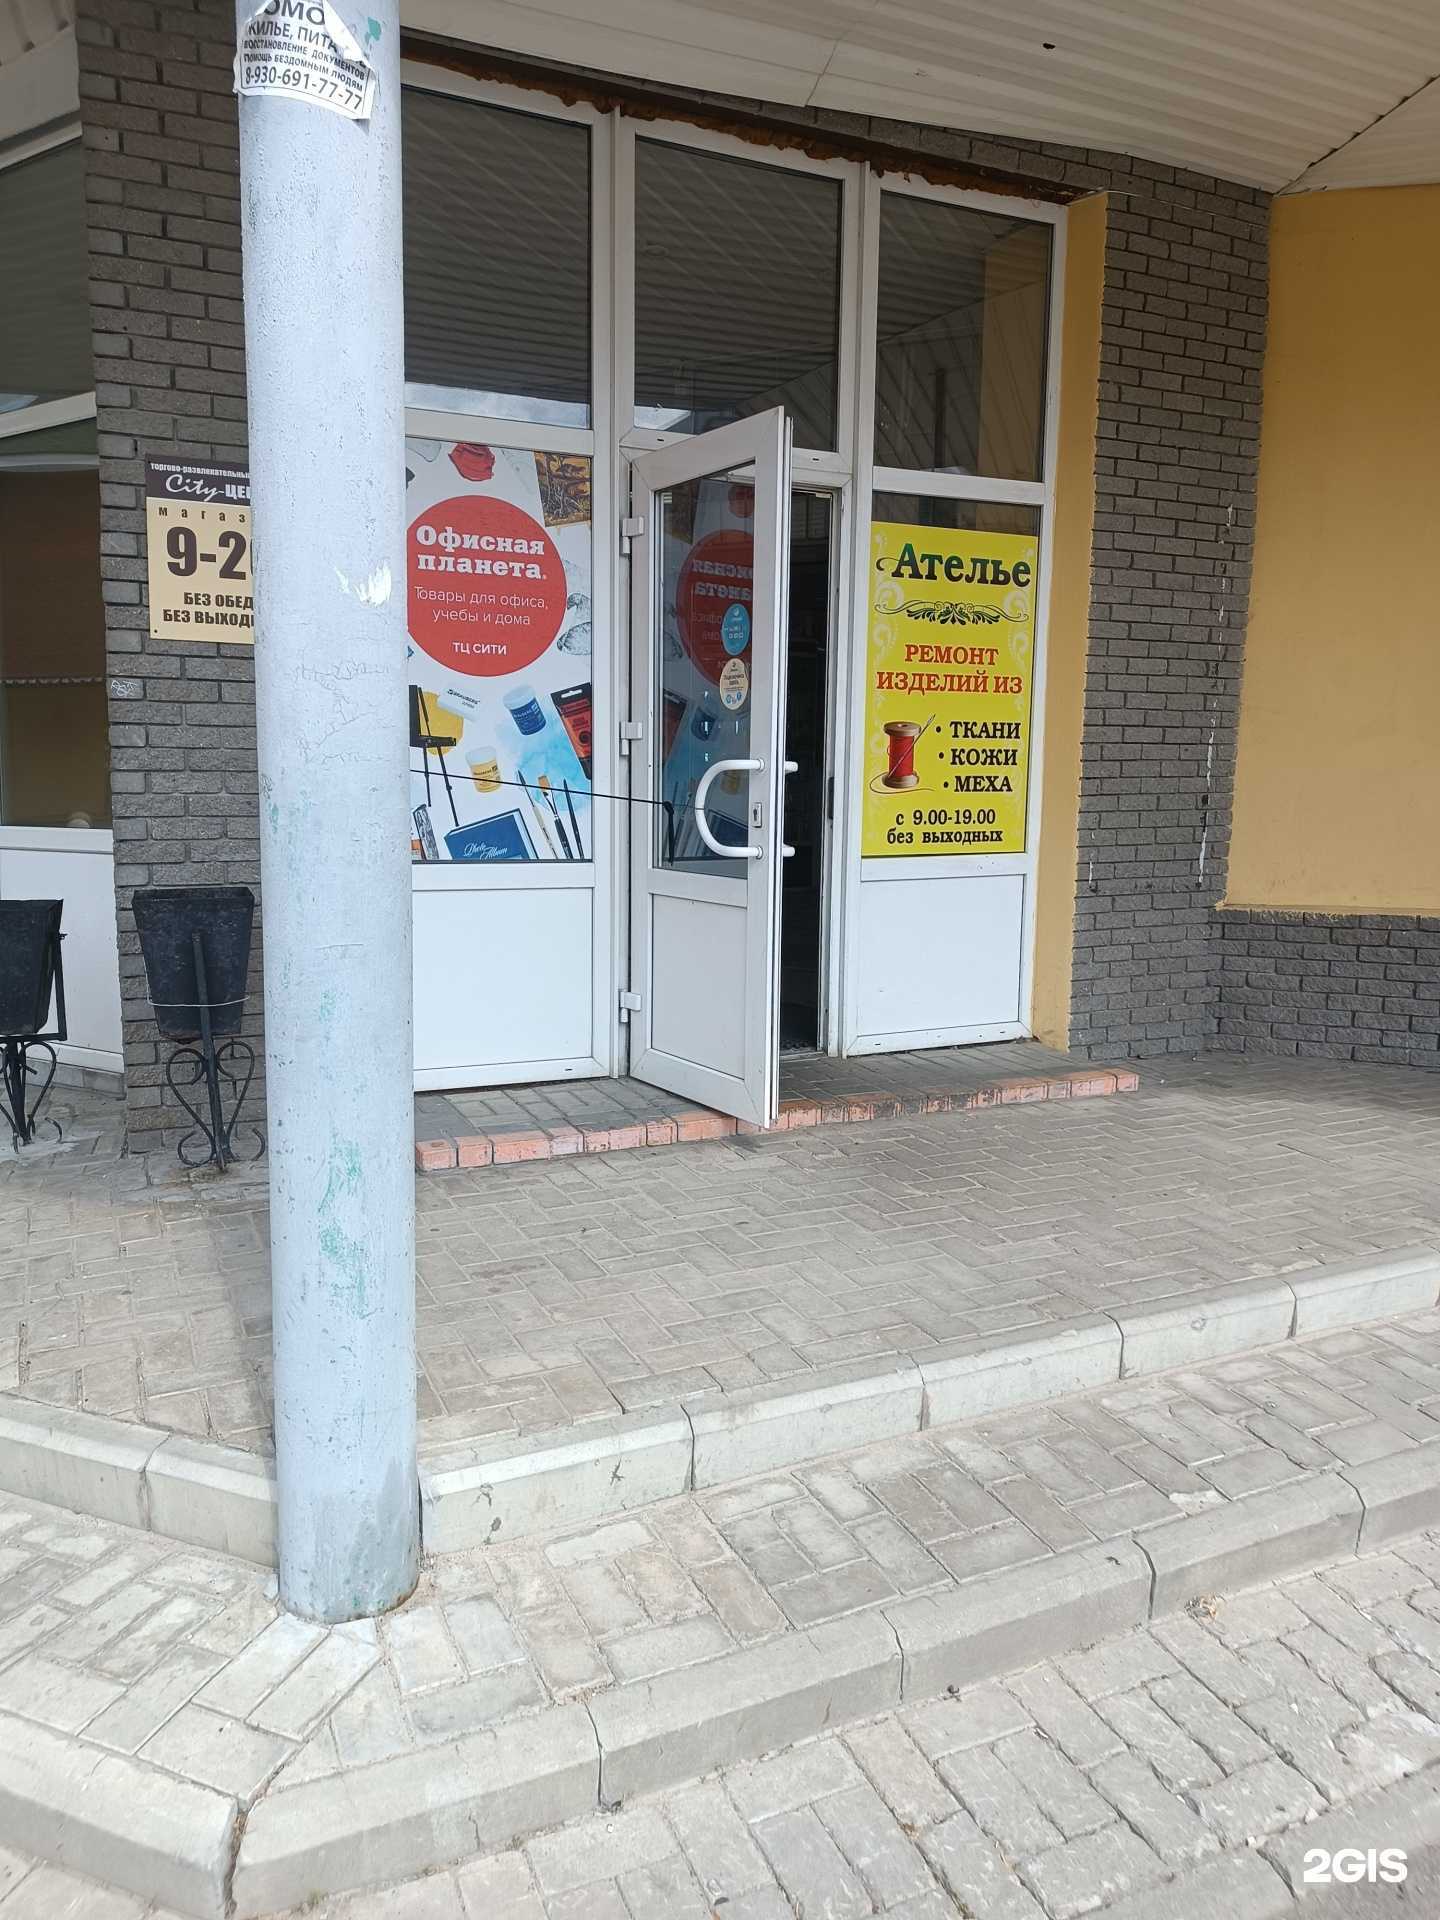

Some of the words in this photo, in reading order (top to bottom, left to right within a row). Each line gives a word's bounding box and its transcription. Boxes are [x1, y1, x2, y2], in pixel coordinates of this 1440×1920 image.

[274, 54, 329, 75] БЕЗДОМНЫМ
[331, 70, 363, 92] ЛЮДЯМ
[311, 50, 365, 81] ДОКУМЕНТОВ
[245, 66, 363, 110] 8-930-691-77-77
[416, 525, 545, 555] Офисная
[166, 526, 254, 581] 9-2
[876, 543, 1031, 587] Ателье
[183, 592, 211, 606] БЕЗ
[414, 586, 466, 604] Товары
[469, 593, 496, 605] для
[500, 594, 548, 610] офиса,
[163, 609, 191, 623] БЕЗ
[432, 609, 479, 623] учебы
[483, 614, 491, 622] и
[495, 615, 530, 626] дома
[453, 642, 470, 654] ТЦ
[473, 643, 507, 655] СИТИ
[905, 644, 999, 666] РЕМОНТ
[876, 669, 989, 695] ИЗДЕЛИЙ
[993, 675, 1023, 694] ИЗ
[950, 721, 1021, 739] ТКАНИ
[950, 748, 1018, 766] КОЖИ
[954, 775, 1013, 793] МЕХА
[895, 813, 905, 826] с
[912, 808, 996, 826] 9.00-19.00
[887, 827, 914, 844] без
[922, 830, 1003, 846] выходных
